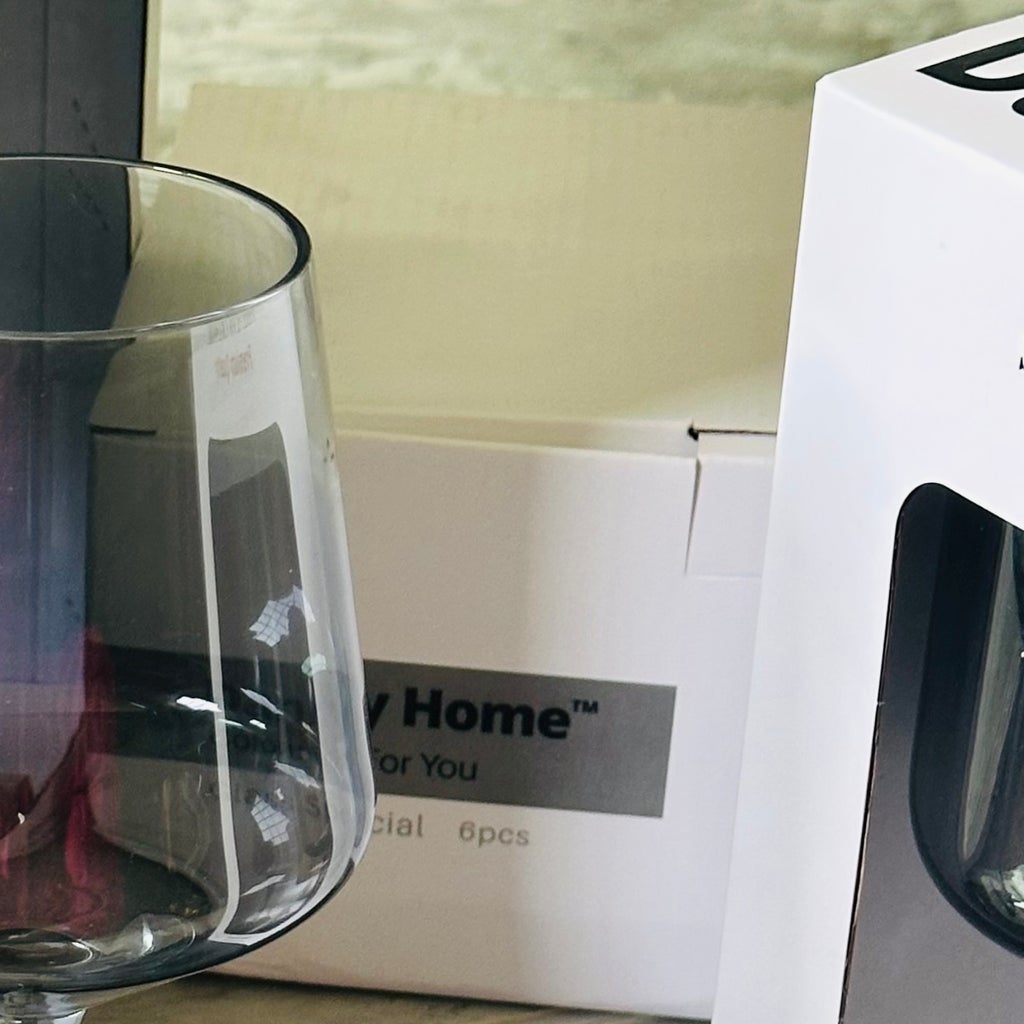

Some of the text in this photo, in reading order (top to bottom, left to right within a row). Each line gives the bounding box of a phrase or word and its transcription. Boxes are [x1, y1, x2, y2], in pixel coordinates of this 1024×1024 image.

[421, 752, 478, 782] You
[372, 811, 530, 847] cial 6pcs
